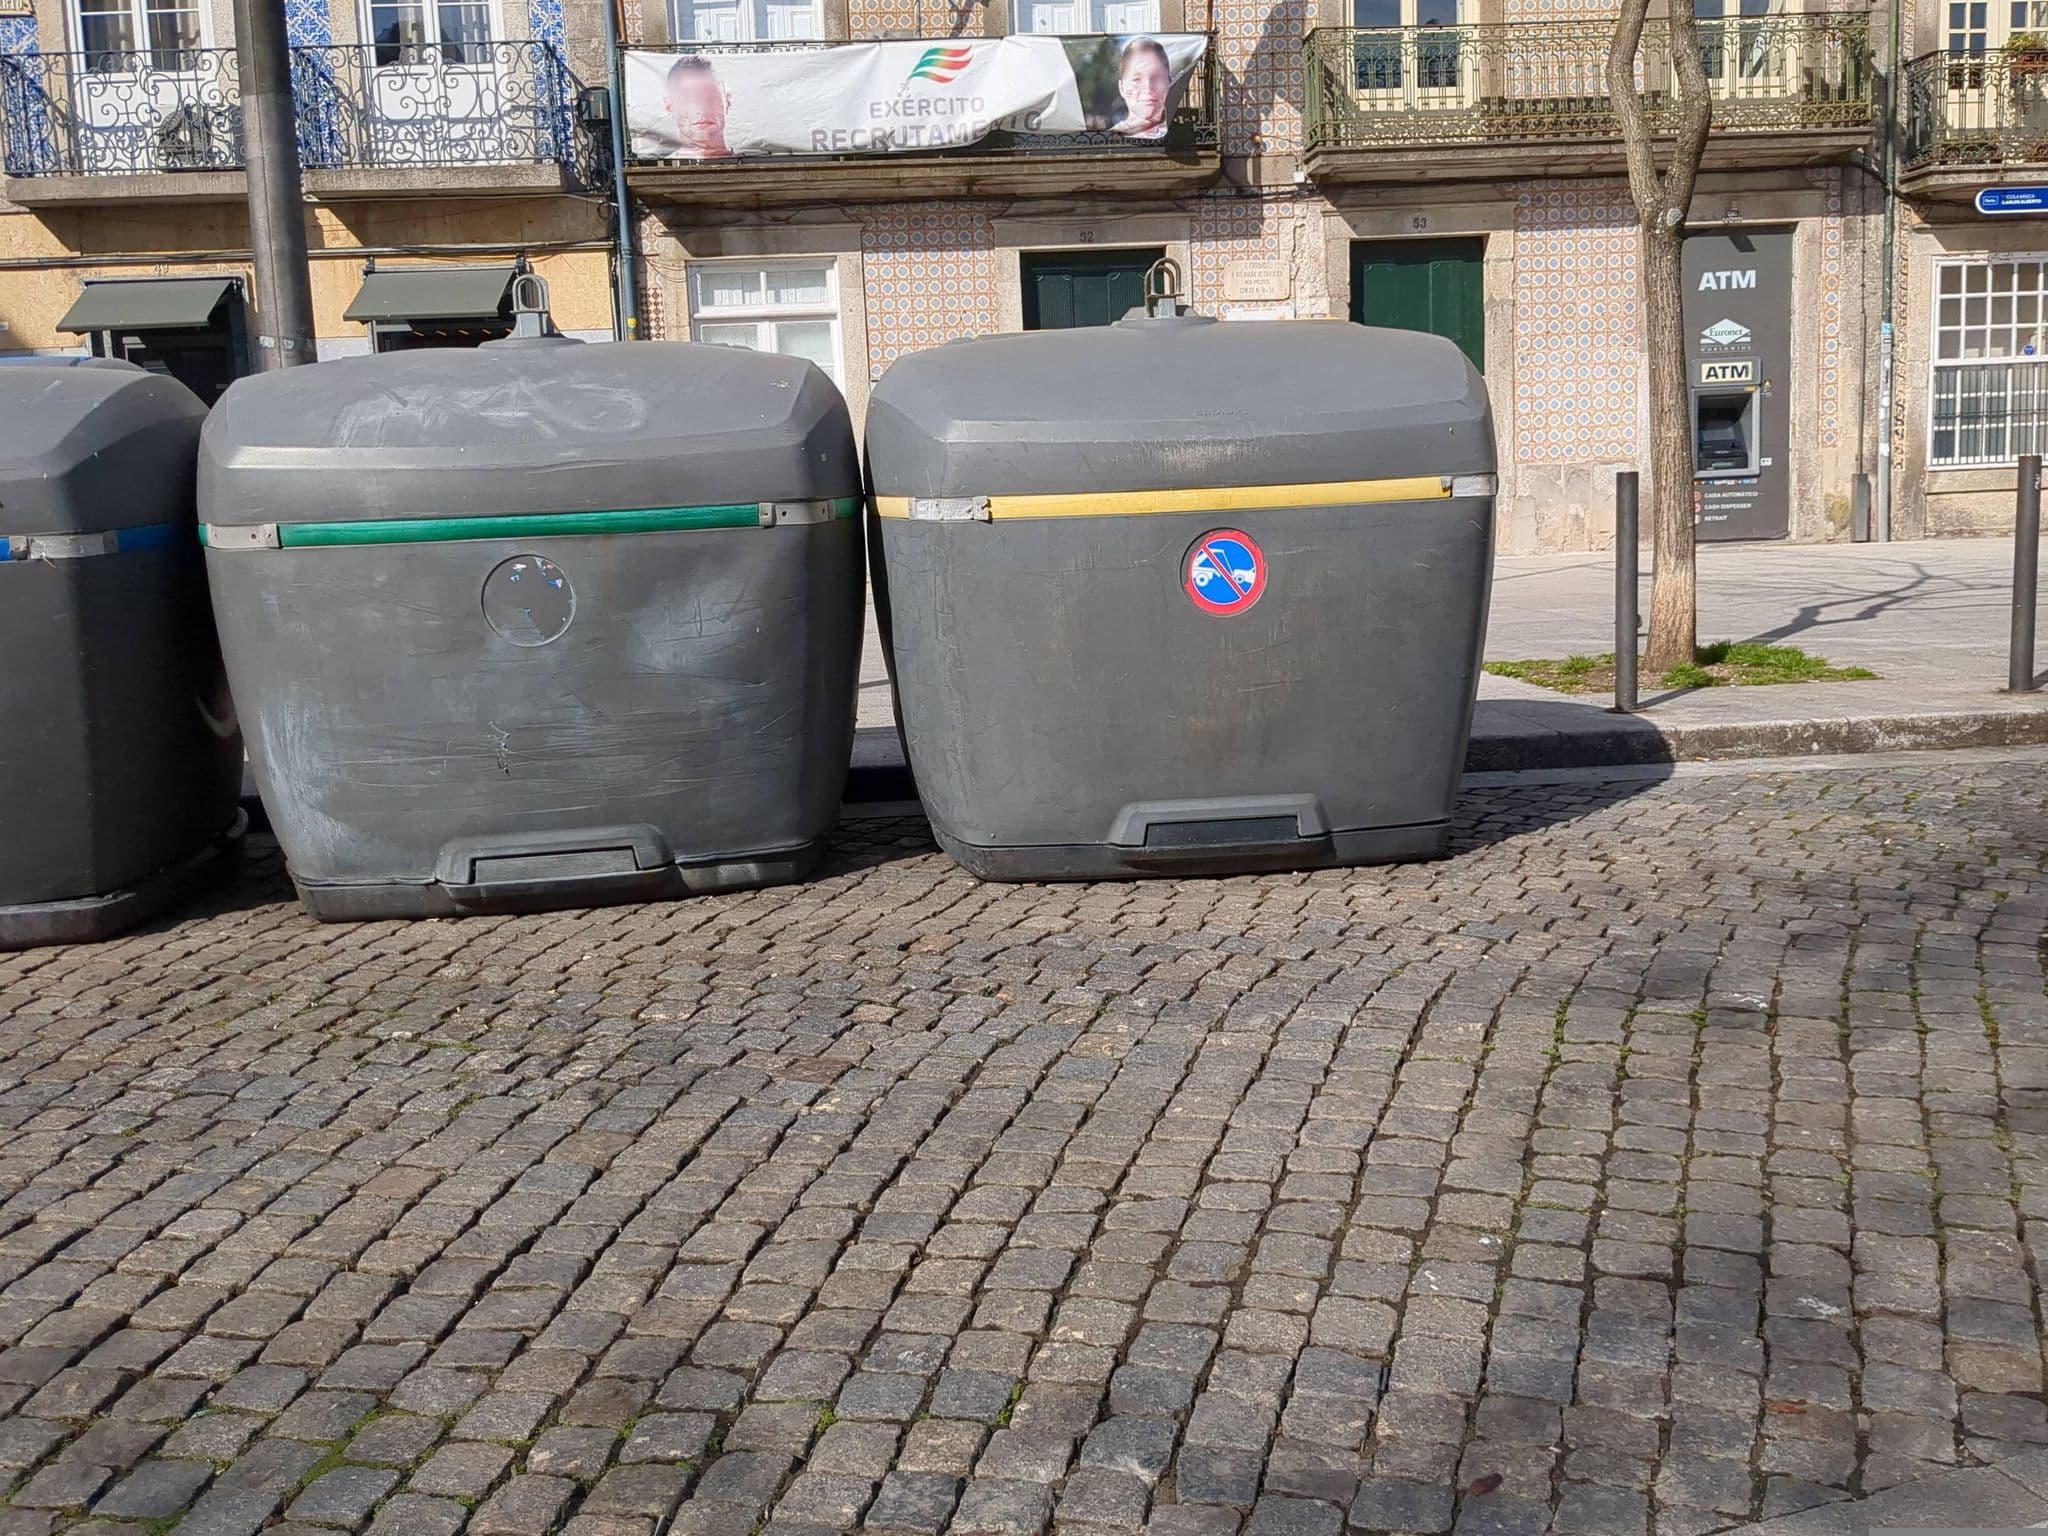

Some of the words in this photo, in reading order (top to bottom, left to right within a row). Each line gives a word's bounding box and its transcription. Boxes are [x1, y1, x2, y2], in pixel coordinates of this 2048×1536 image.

[870, 94, 985, 119] EXÉRCITO
[1413, 217, 1427, 229] 53
[1698, 270, 1757, 291] ATM
[1709, 328, 1743, 337] Euronet
[1705, 364, 1750, 380] ATM
